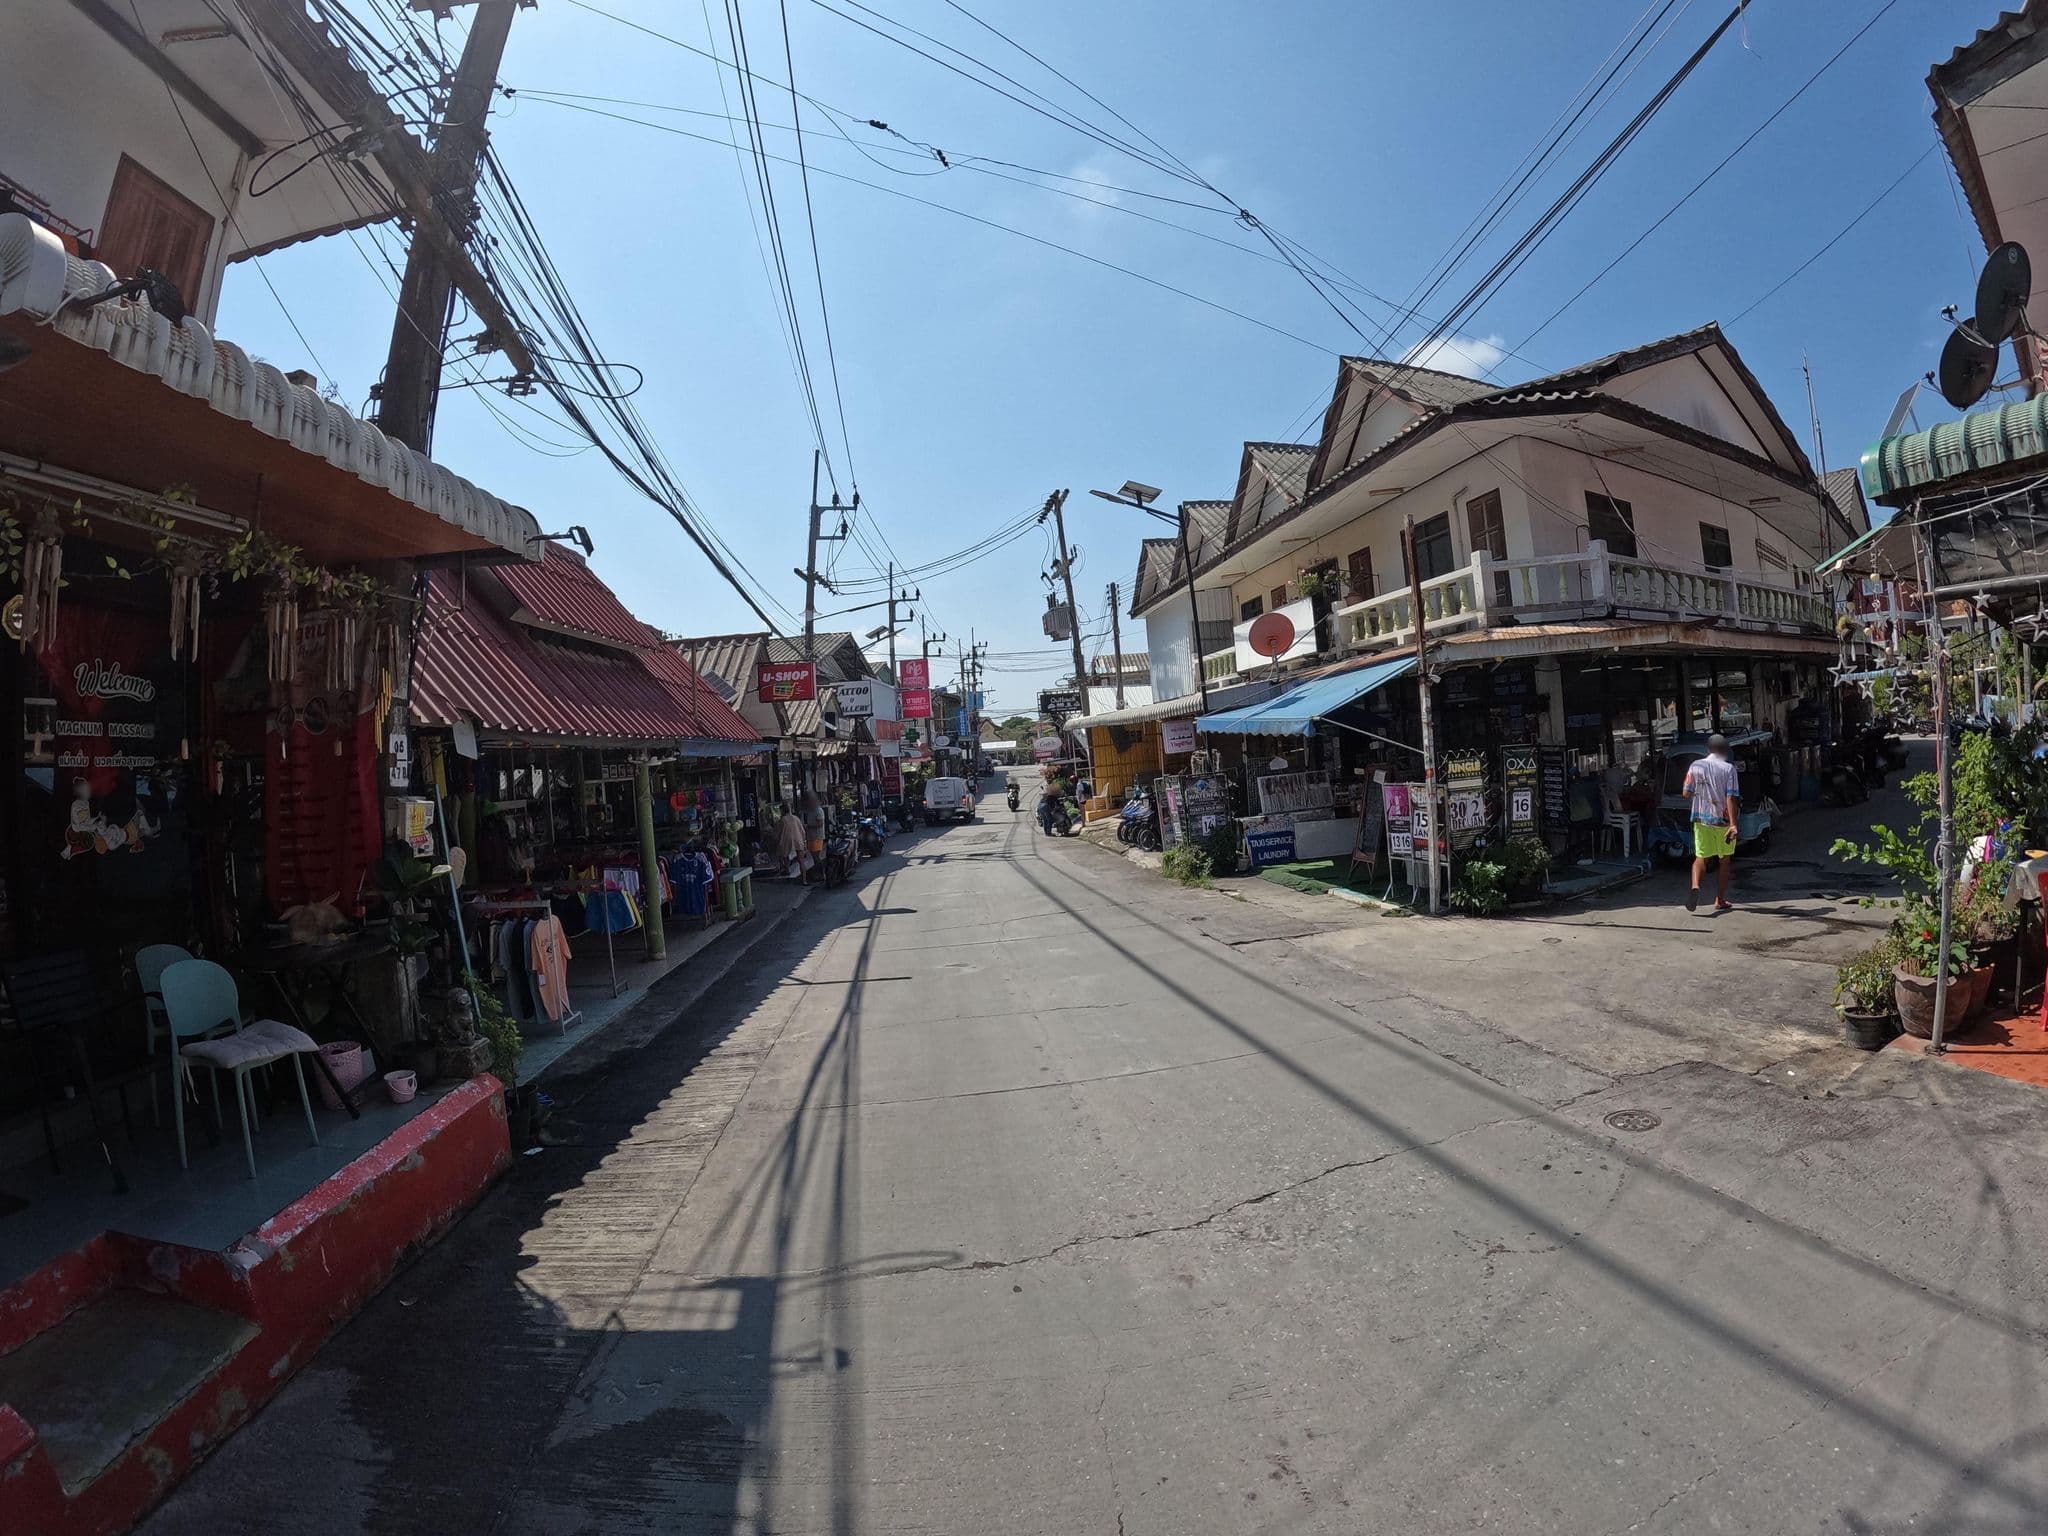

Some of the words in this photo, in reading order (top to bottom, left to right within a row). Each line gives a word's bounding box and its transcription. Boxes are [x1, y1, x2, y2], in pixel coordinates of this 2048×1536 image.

[74, 658, 157, 703] Welcome
[762, 671, 809, 683] U-SHOP
[838, 686, 869, 696] ATTOO
[56, 720, 103, 737] MAGNUM
[1447, 760, 1480, 773] JUNGLE
[1188, 790, 1225, 800] WATERFALL
[1450, 801, 1466, 819] 30
[1470, 800, 1479, 817] 2
[1514, 799, 1529, 812] 16
[1204, 819, 1214, 832] 14
[1415, 813, 1429, 828] 15
[1451, 818, 1466, 830] DEC
[1470, 816, 1483, 828] JAN
[1414, 828, 1429, 838] JAN
[1250, 839, 1265, 848] TAXI
[1265, 836, 1294, 846] SERVICE
[1393, 835, 1401, 848] 13
[1402, 835, 1411, 848] 16
[1258, 849, 1290, 860] LAUNDRY
